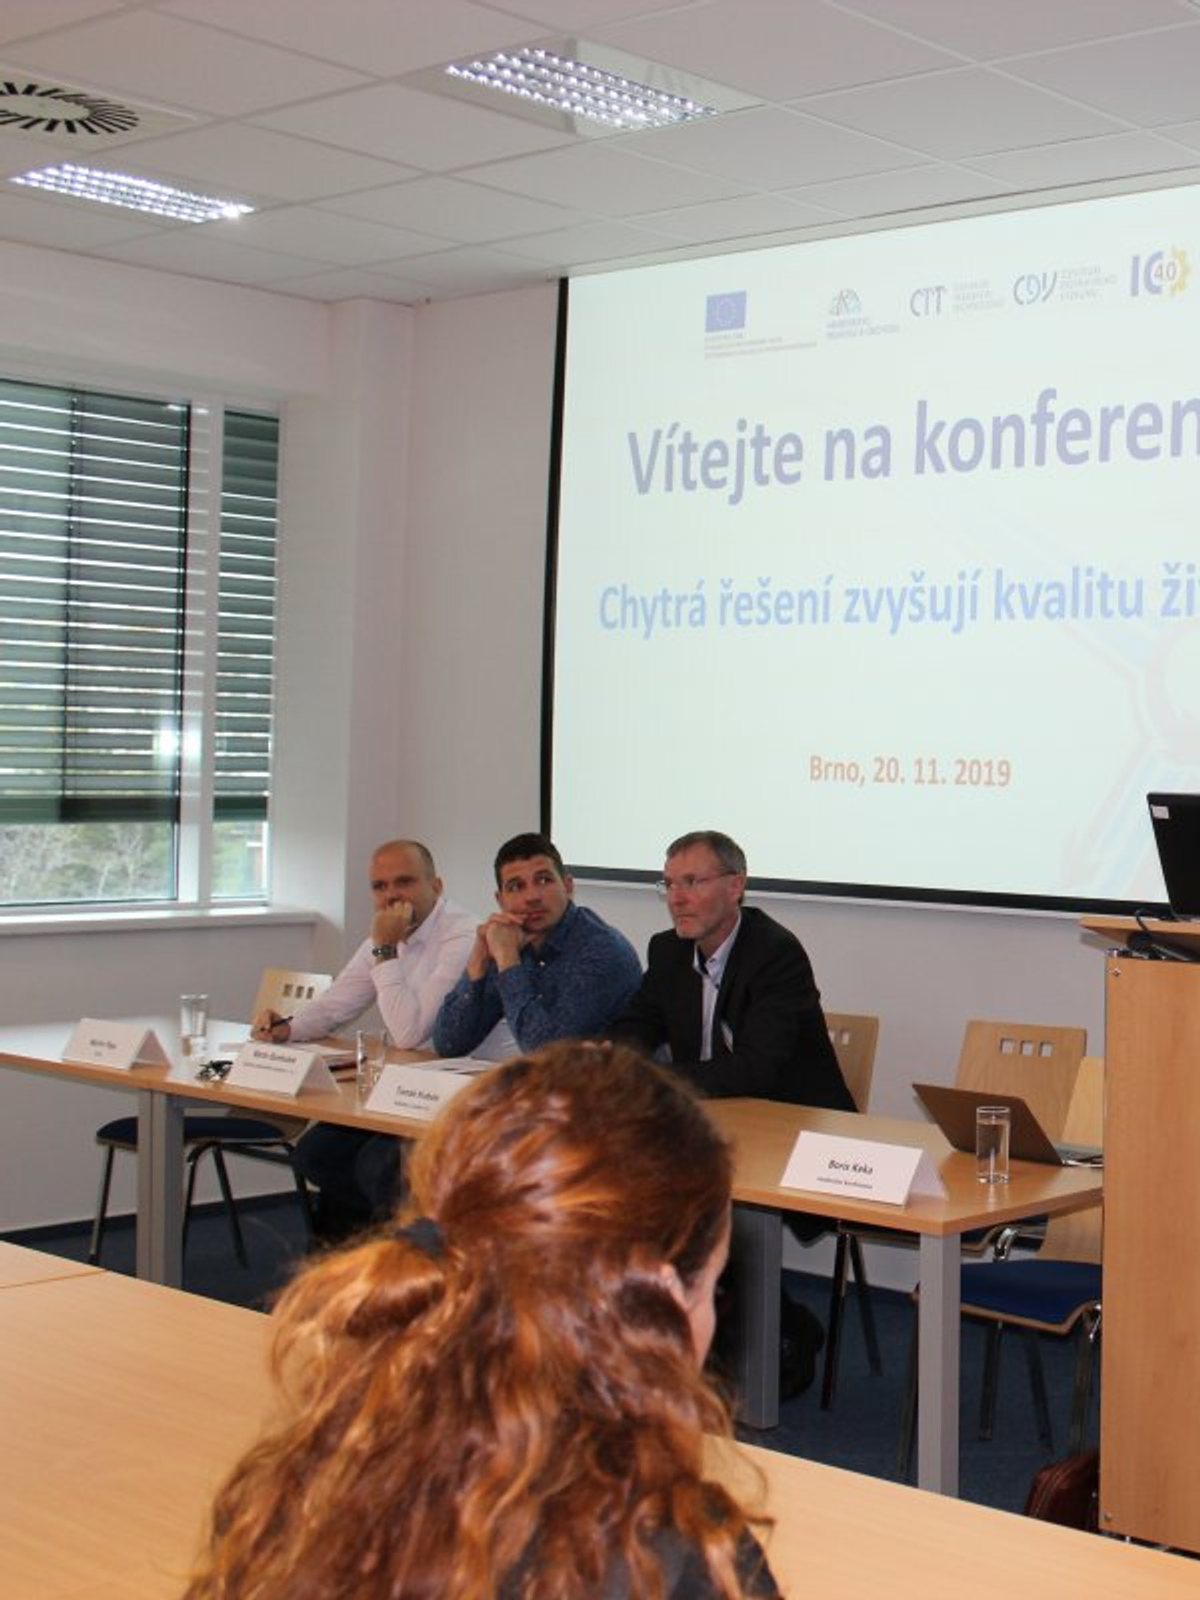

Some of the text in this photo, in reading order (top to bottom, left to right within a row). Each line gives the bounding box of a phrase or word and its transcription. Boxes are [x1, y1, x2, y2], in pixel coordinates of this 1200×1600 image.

[909, 286, 946, 317] CTT
[627, 417, 803, 505] Vítejte
[823, 423, 893, 481] na
[599, 579, 707, 639] Chytrá
[718, 574, 834, 627] řešení
[843, 569, 981, 635] zvyšují
[994, 566, 1144, 621] kvalitu
[809, 755, 1012, 788] Brno, 20. 11. 2019
